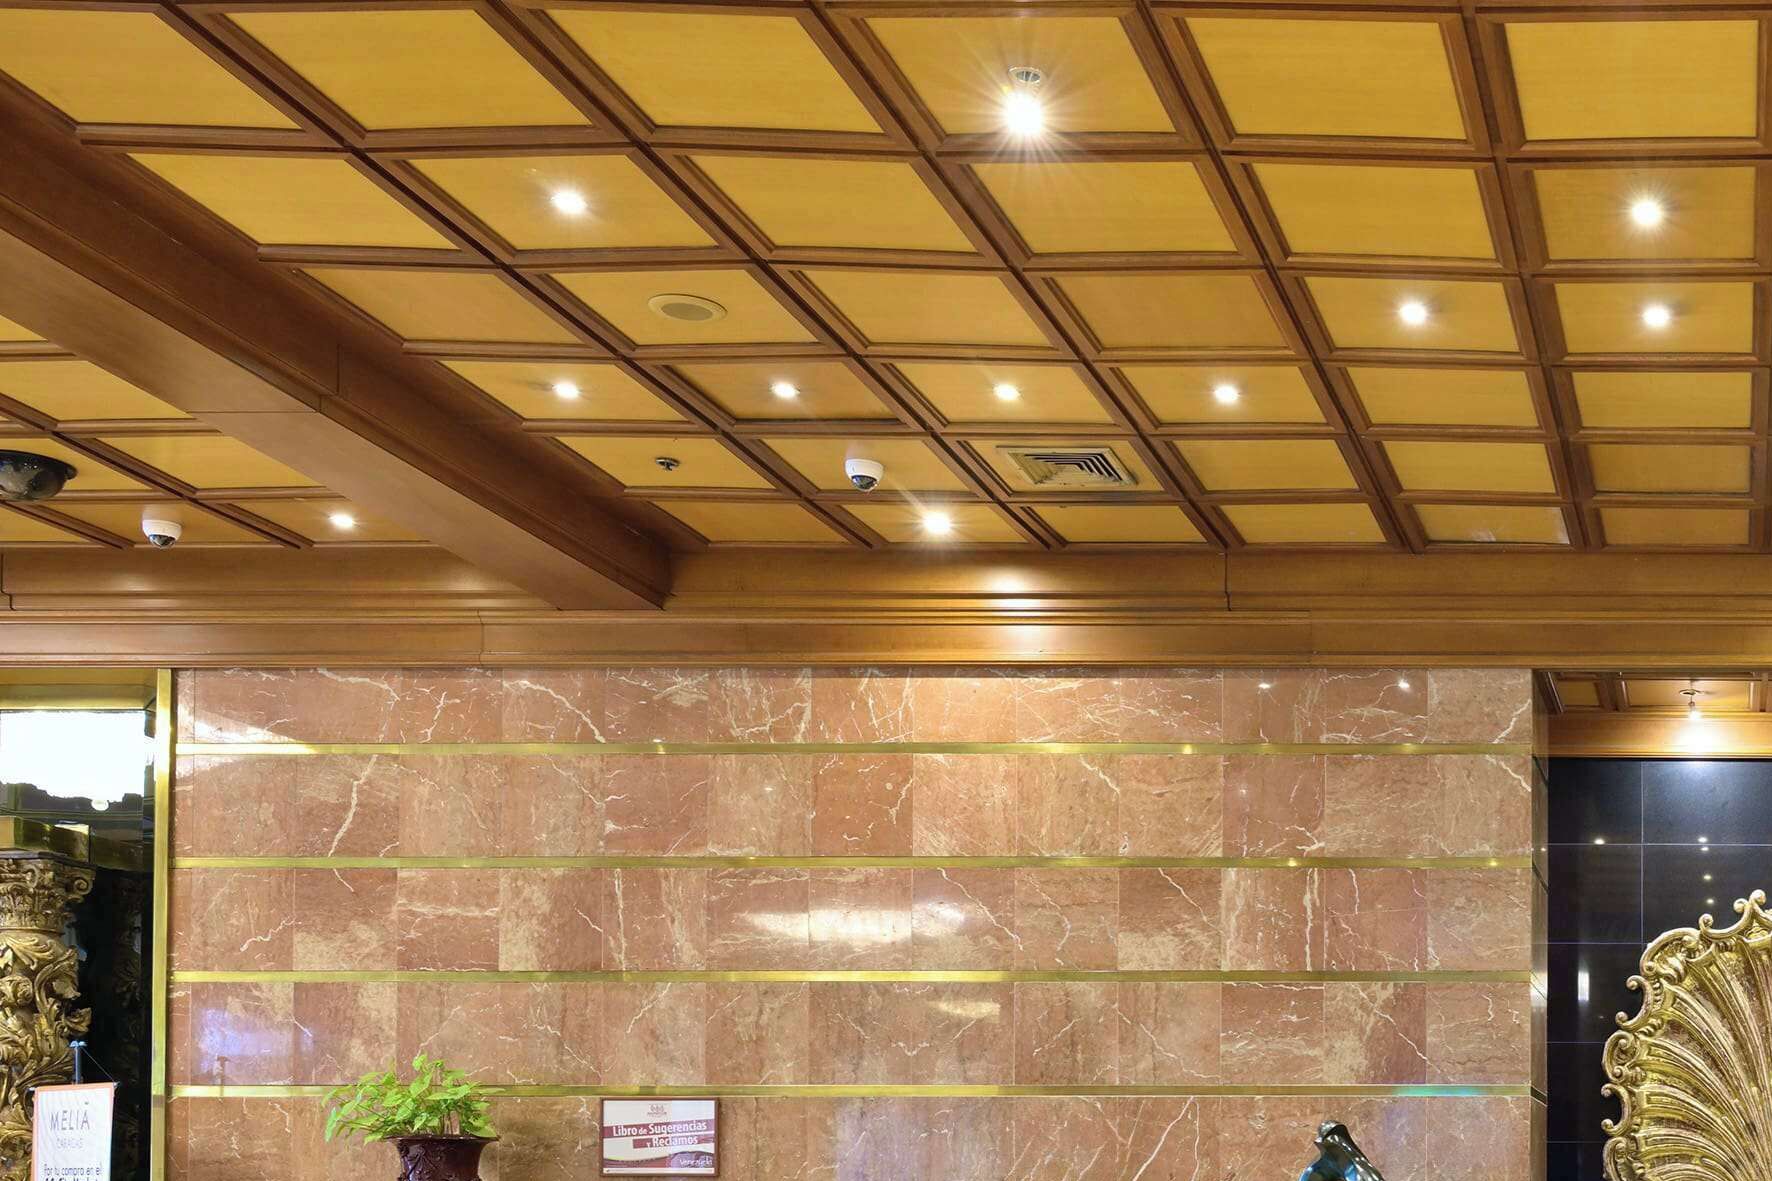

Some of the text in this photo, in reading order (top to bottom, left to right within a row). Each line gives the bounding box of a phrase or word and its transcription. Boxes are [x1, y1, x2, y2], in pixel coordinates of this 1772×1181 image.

[612, 1125, 637, 1137] Libro
[649, 1120, 708, 1135] Sugerencias
[652, 1136, 698, 1147] Reclamos
